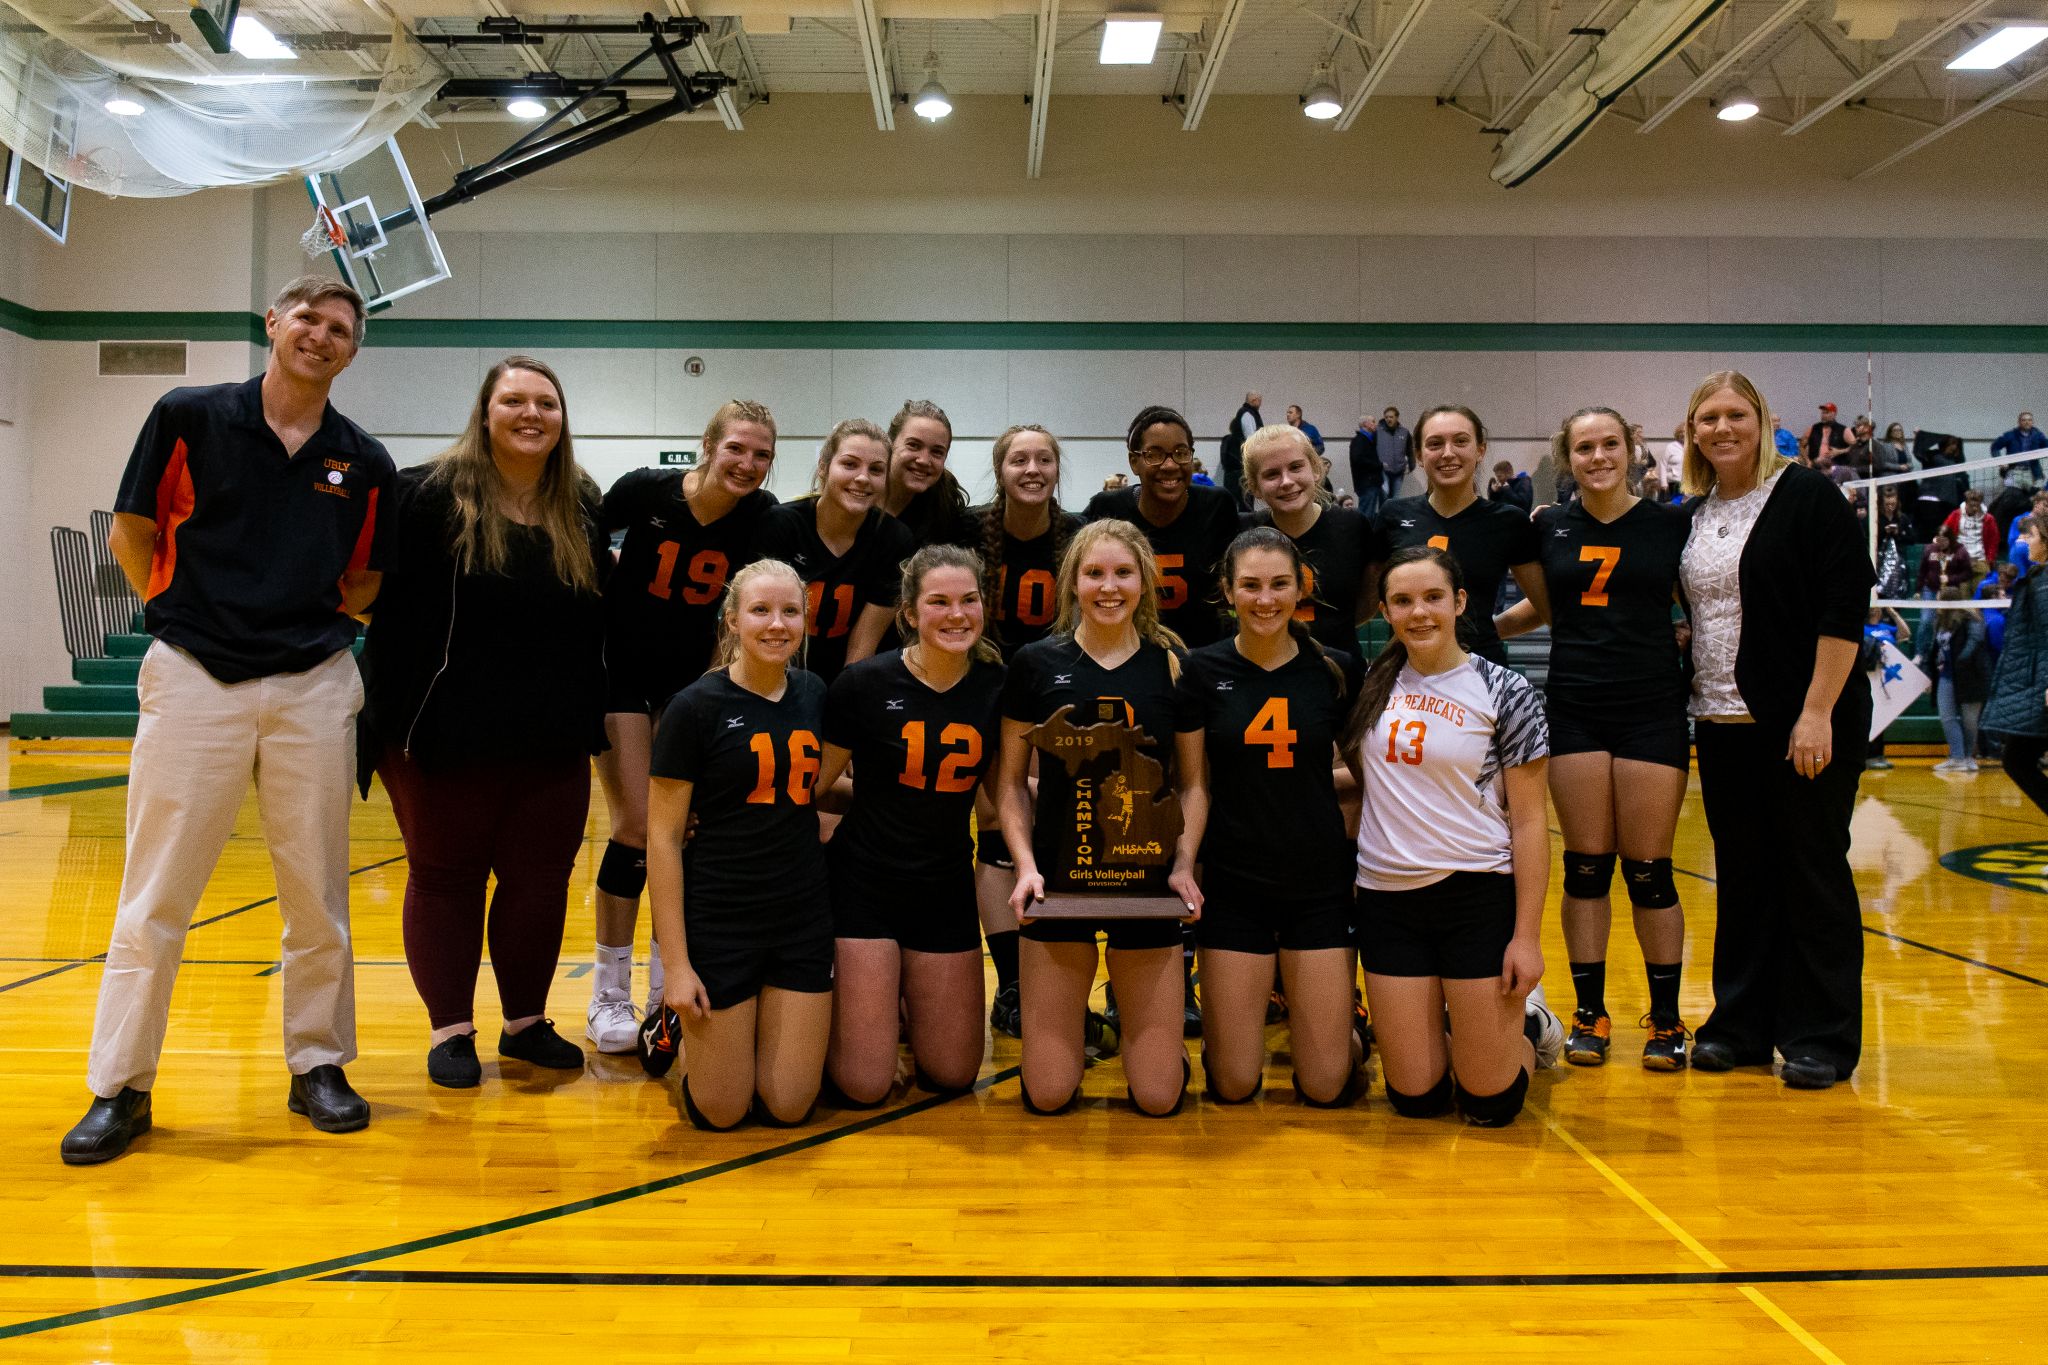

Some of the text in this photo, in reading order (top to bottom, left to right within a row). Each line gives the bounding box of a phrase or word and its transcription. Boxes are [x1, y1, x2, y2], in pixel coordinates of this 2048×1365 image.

[323, 458, 351, 471] UBLY
[667, 454, 691, 463] G.H.S.
[648, 540, 729, 605] 19
[1152, 554, 1187, 609] 5
[1579, 545, 1621, 606] 7
[807, 581, 854, 638] 11
[1244, 696, 1297, 768] 4
[1404, 694, 1466, 727] BEARCATS
[746, 730, 821, 805] 16
[898, 720, 983, 793] 12
[1055, 736, 1094, 746] 2019
[1385, 718, 1427, 766] 13
[1076, 778, 1093, 865] CHAMPION
[1069, 869, 1145, 881] Girls Volleyball
